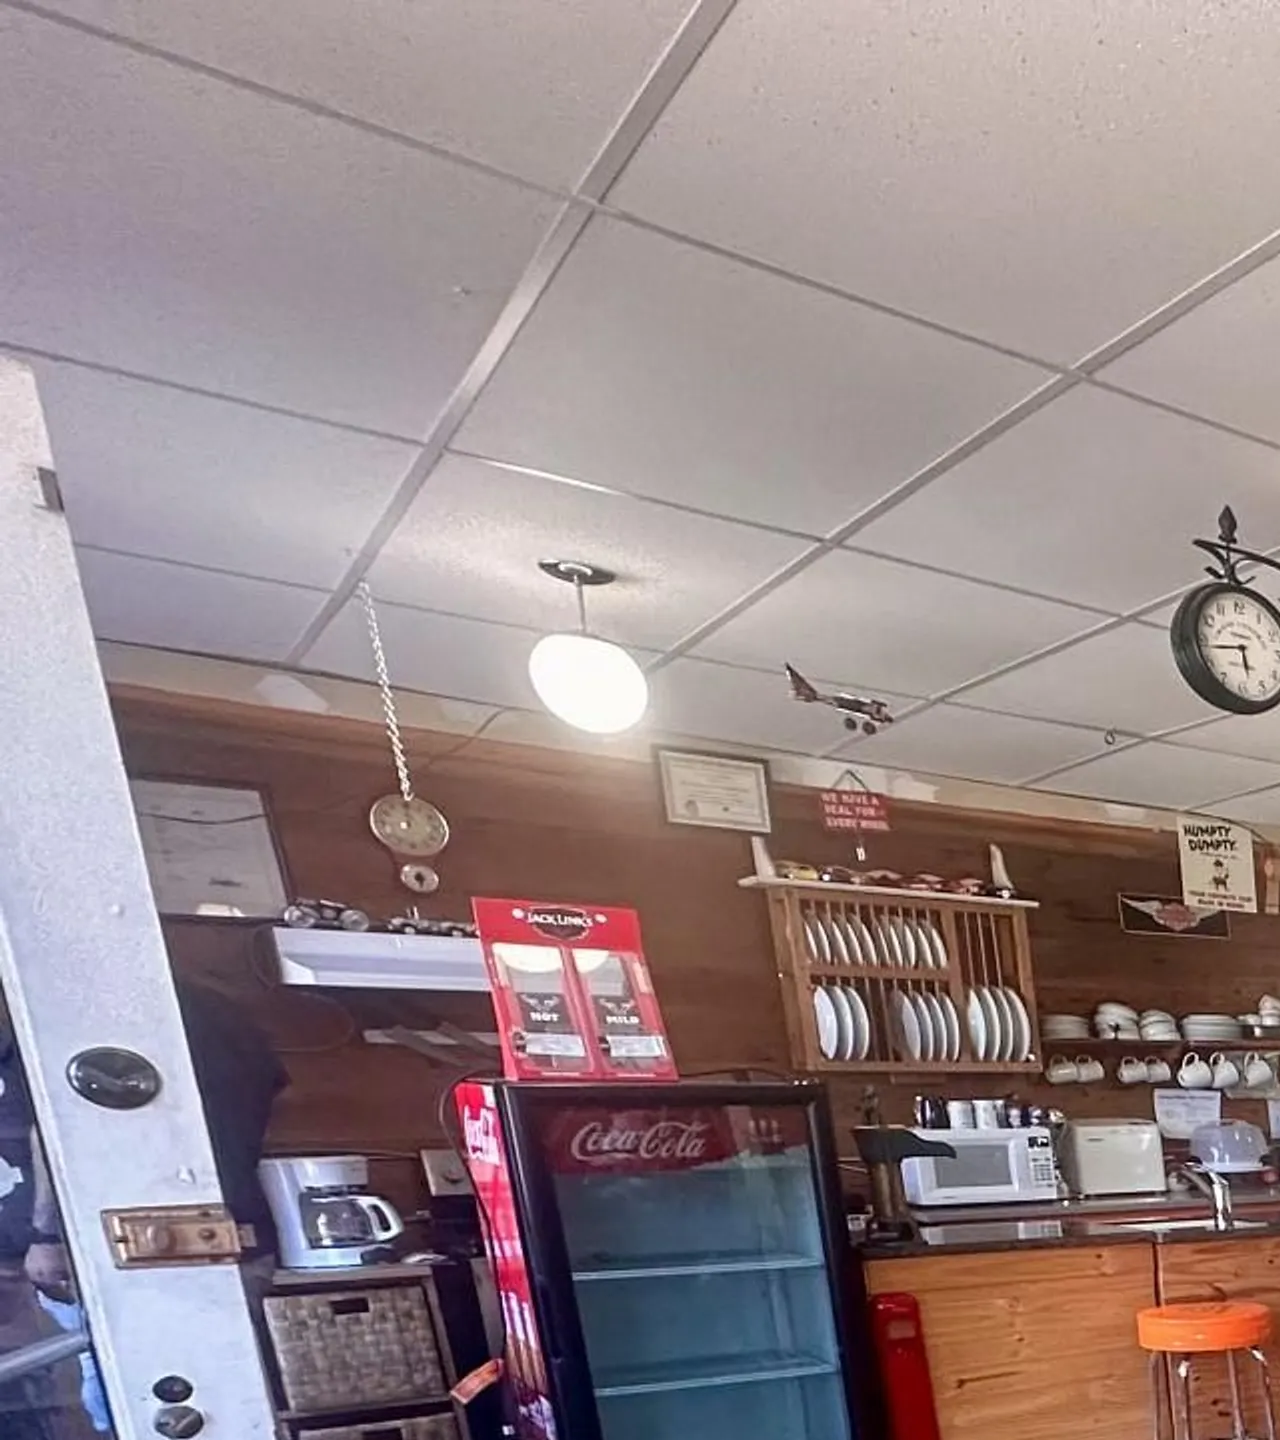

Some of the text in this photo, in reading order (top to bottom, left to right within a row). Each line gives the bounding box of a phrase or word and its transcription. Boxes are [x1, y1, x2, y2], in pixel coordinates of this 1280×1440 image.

[1183, 824, 1231, 837] HUMPTY
[1188, 839, 1236, 851] DUMPTY
[526, 912, 557, 925] JACK
[530, 1011, 560, 1022] HOT
[606, 1014, 640, 1025] MILD
[571, 1120, 709, 1163] Coca-Cola
